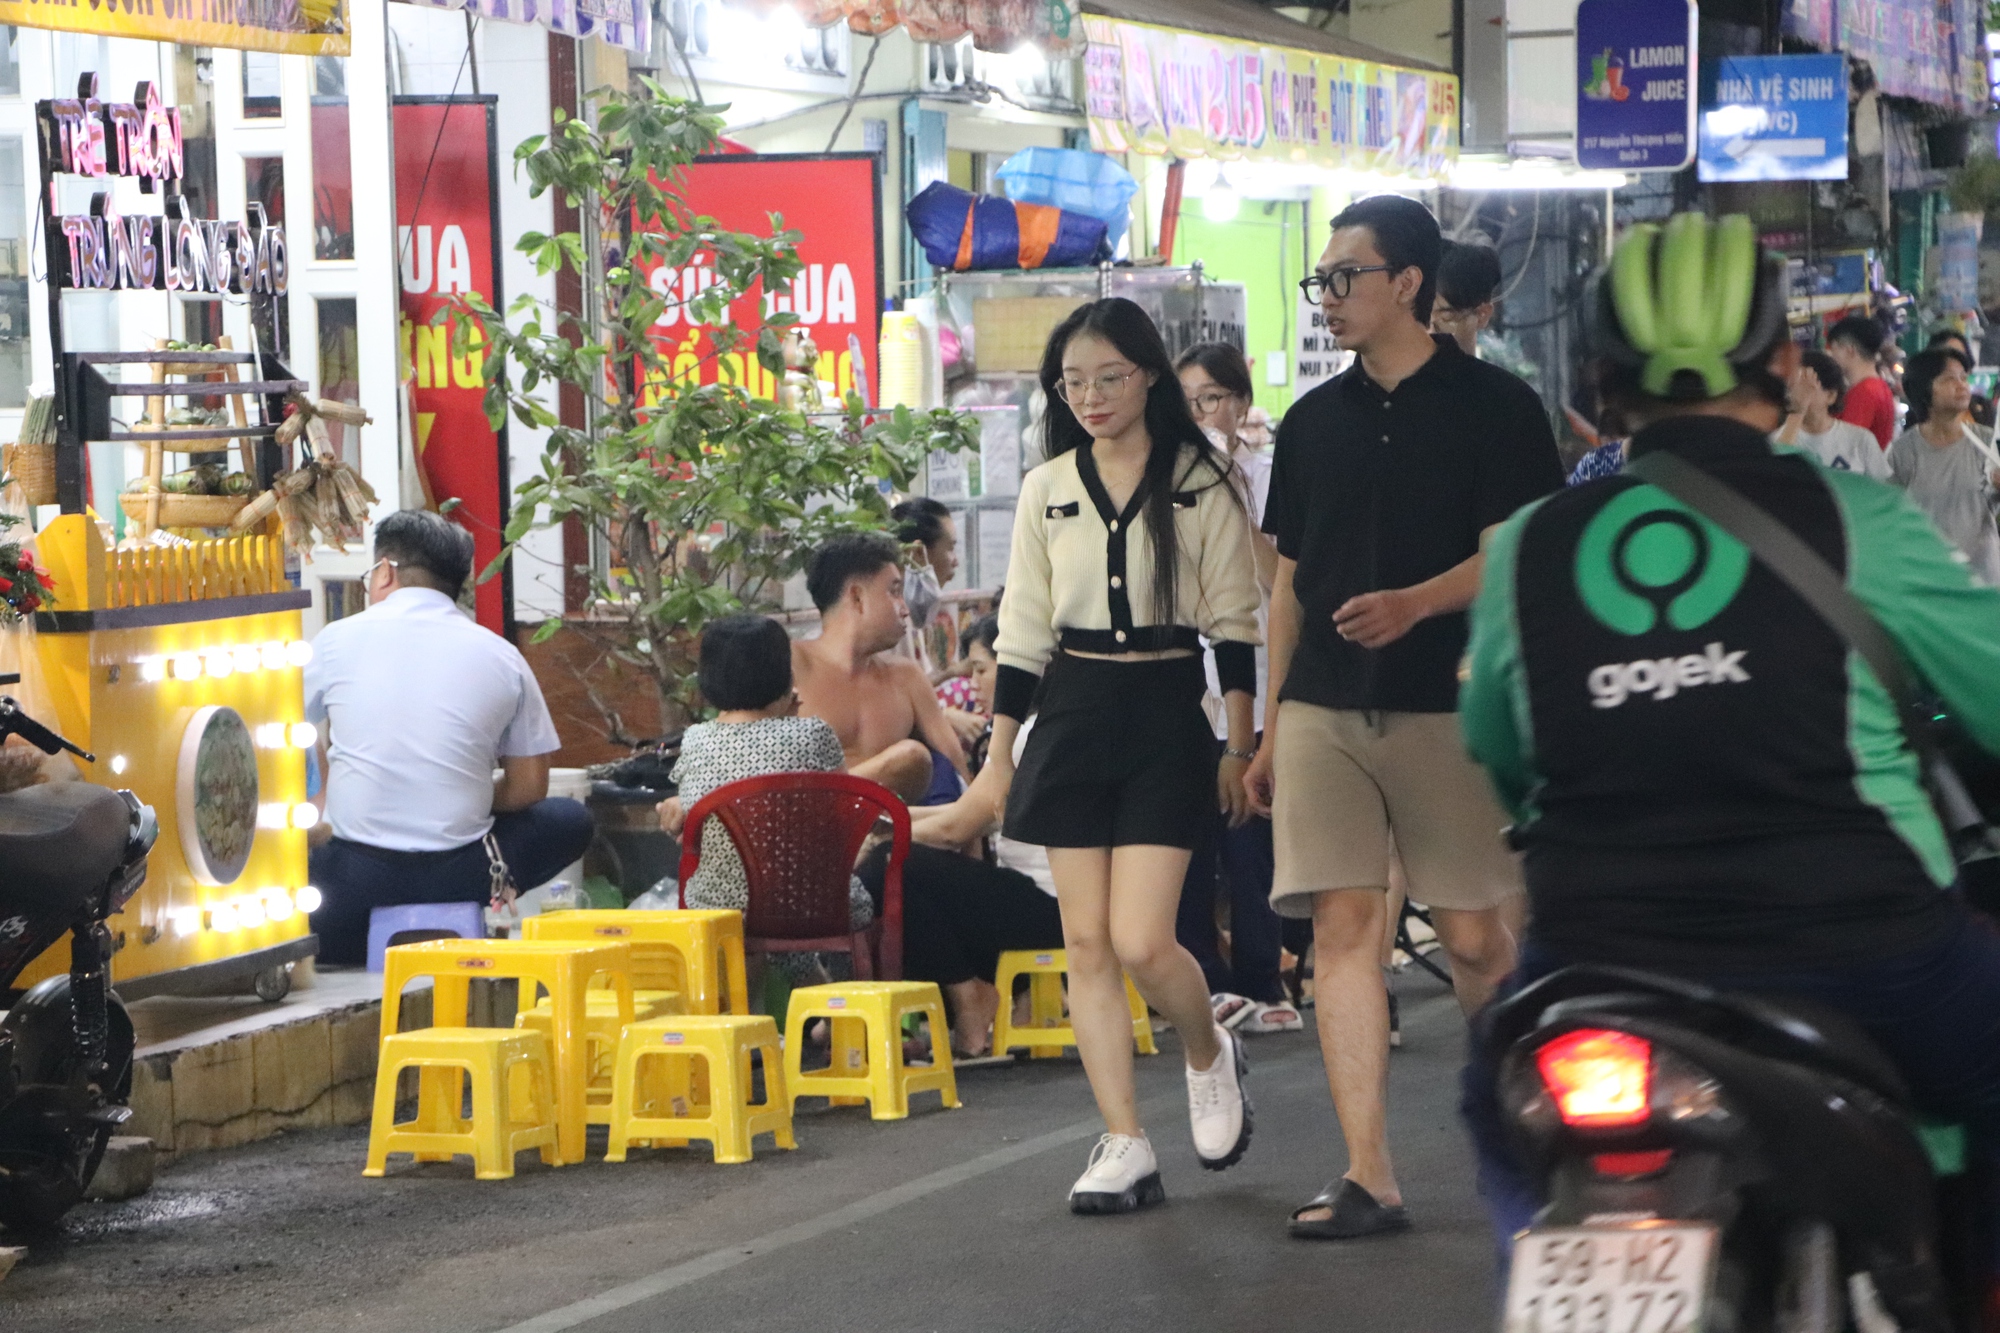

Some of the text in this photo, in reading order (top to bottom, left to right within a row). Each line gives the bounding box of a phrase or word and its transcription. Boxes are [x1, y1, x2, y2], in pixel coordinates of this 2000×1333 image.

[1630, 45, 1685, 68] LAMON
[1205, 48, 1267, 148] 215
[1642, 79, 1685, 101] JUICE
[1716, 73, 1833, 105] NHÀ VỆ SINH
[1303, 332, 1318, 352] MÌ
[1299, 360, 1321, 377] NUI
[1587, 641, 1751, 709] gojek
